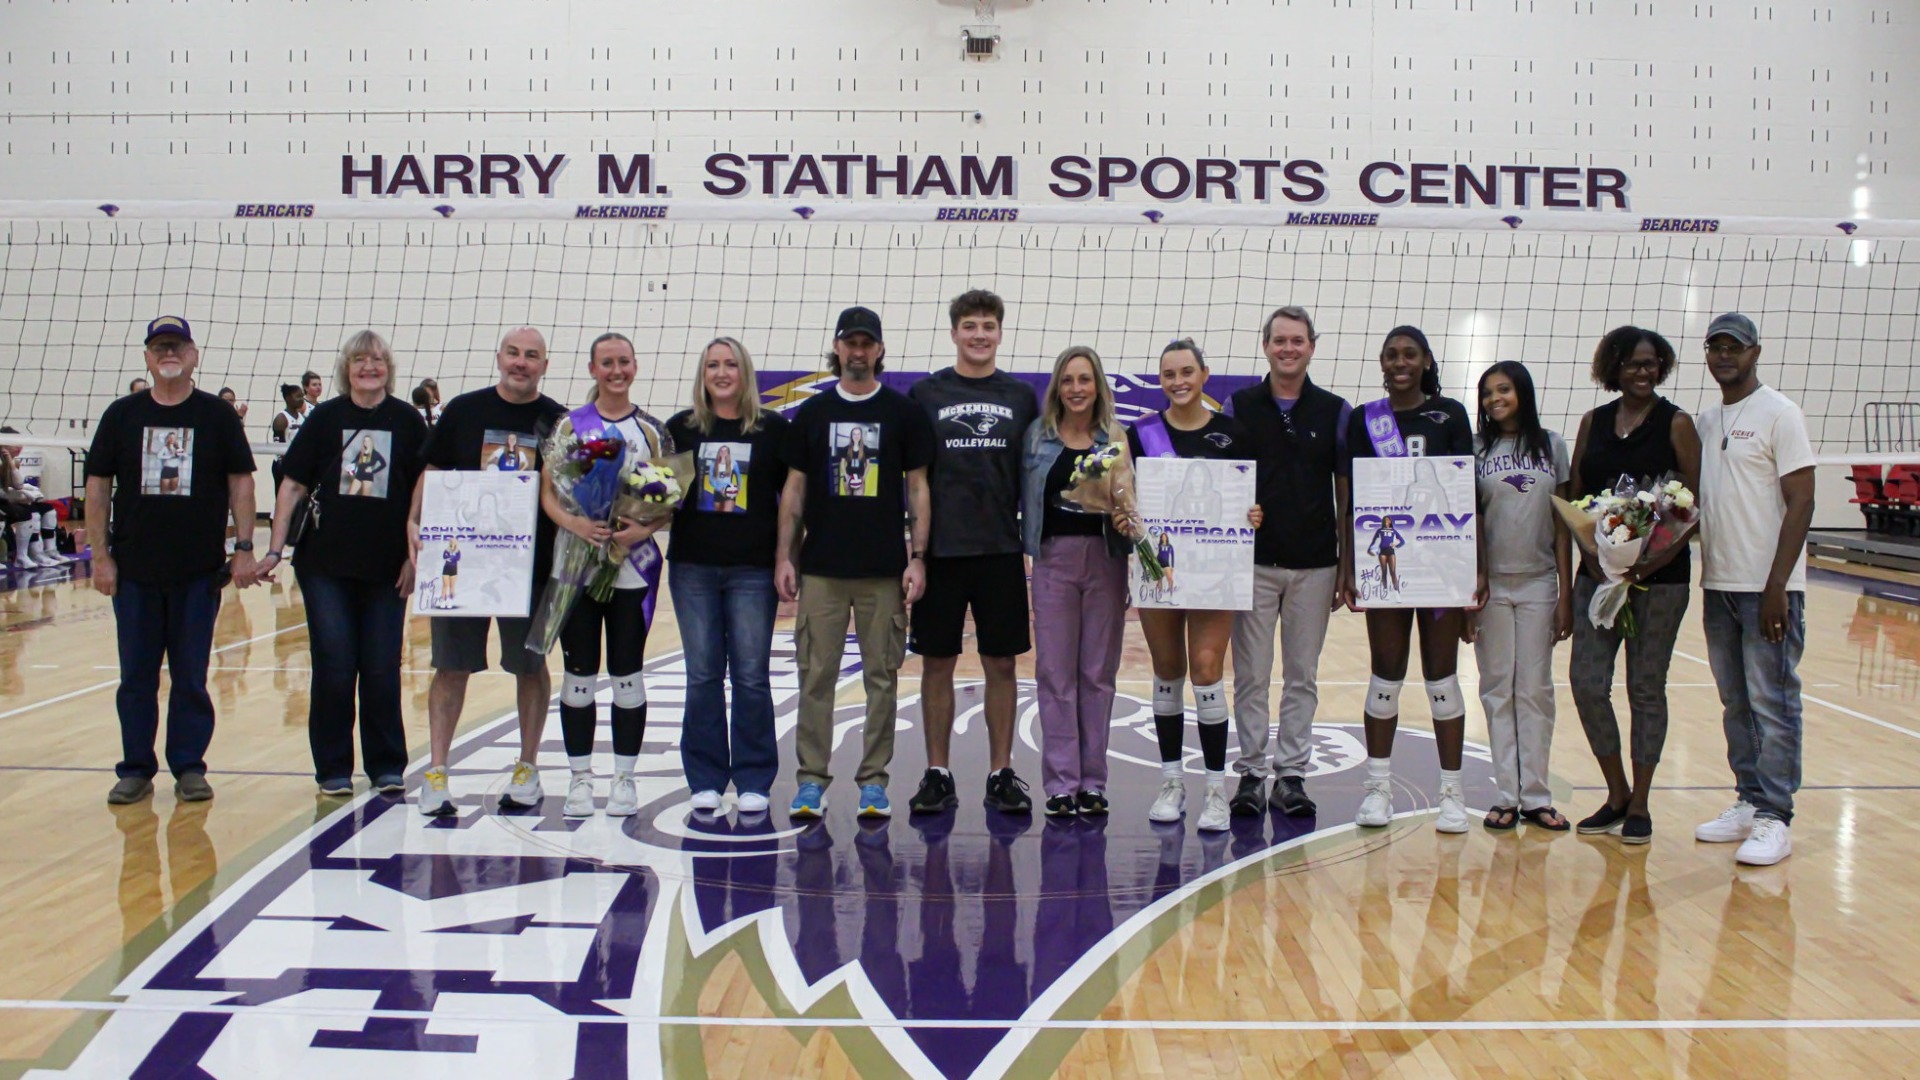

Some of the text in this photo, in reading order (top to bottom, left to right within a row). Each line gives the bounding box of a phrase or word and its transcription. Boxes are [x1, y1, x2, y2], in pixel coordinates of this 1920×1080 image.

[342, 153, 1628, 209] HARRY M. STATHAM SPORTS CENTER
[234, 204, 315, 218] BEARCATS
[575, 205, 669, 219] McKENDREE
[935, 207, 1019, 222] BEARCATS
[1284, 212, 1380, 227] McKENDREE
[1637, 218, 1720, 233] BEARCATS
[938, 402, 1013, 420] McKENDREE
[945, 438, 1007, 449] VOLLEYBALL
[1354, 513, 1474, 533] GRAY
